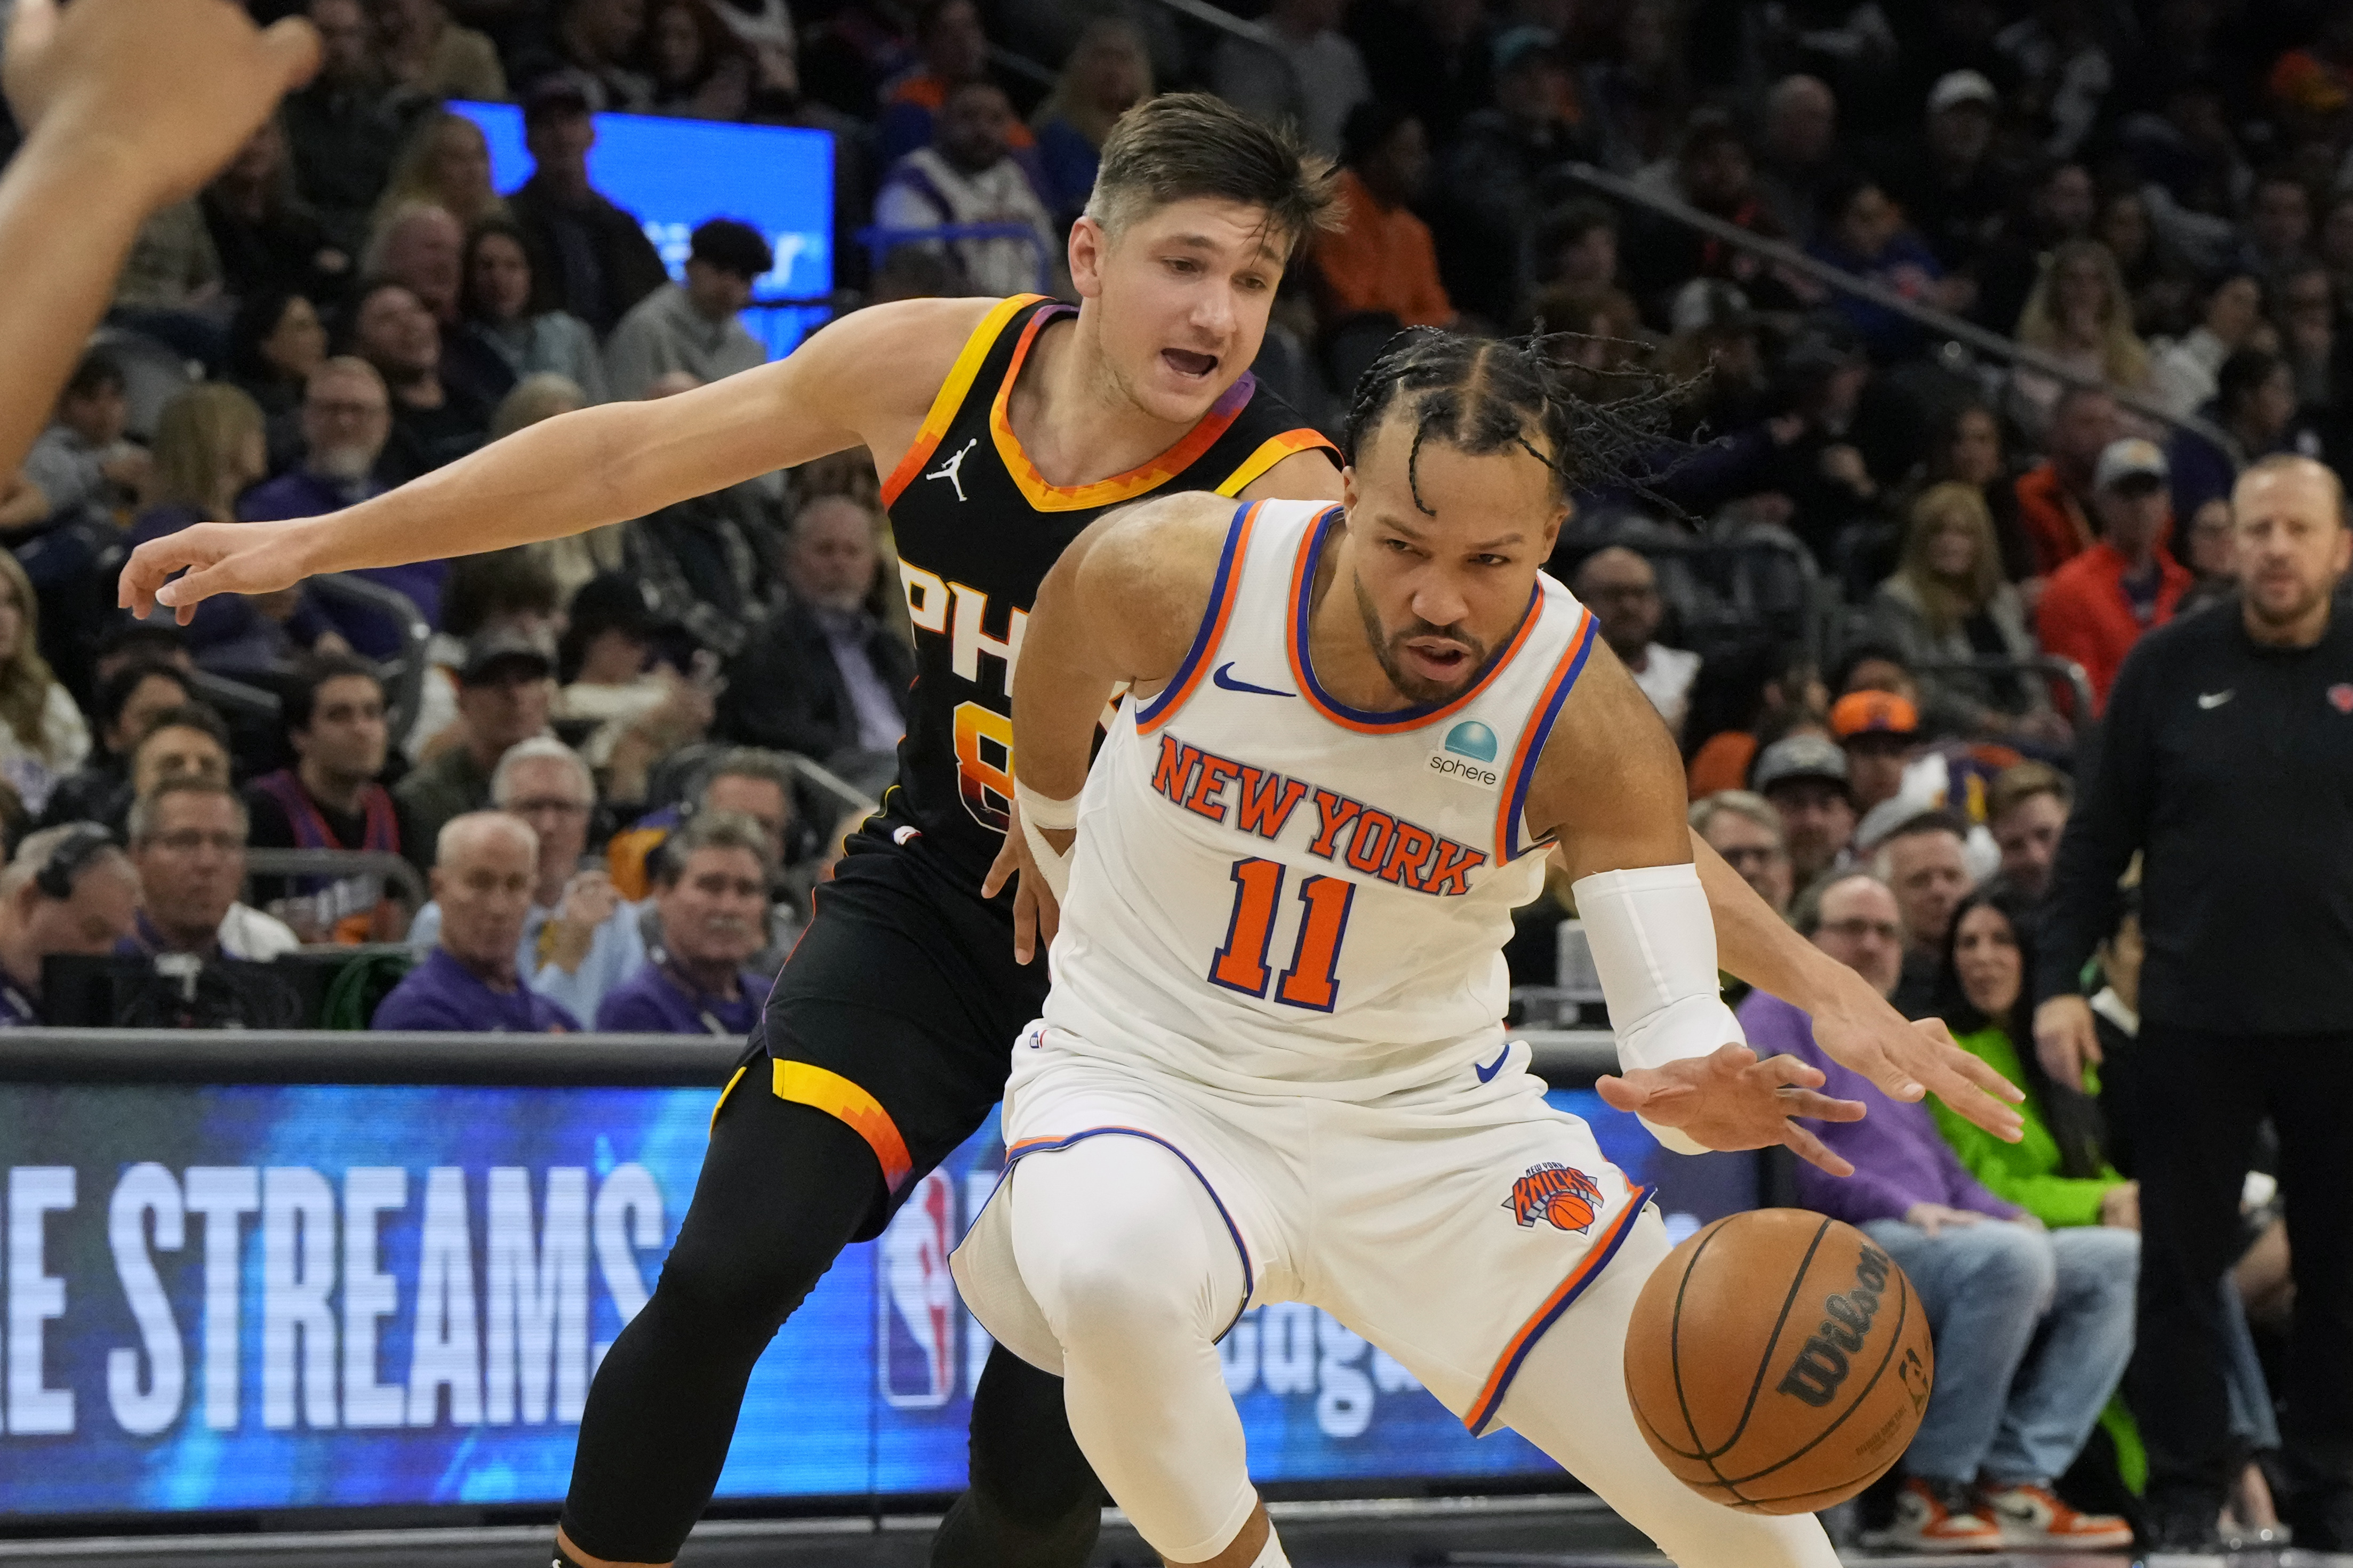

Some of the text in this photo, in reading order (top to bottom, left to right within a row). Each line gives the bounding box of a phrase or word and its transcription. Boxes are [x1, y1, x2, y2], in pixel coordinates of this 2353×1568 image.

[953, 701, 1013, 834] 8
[1150, 732, 1490, 897] NEW YORK
[1430, 757, 1496, 785] sphere
[1207, 856, 1356, 1013] 11
[1512, 1167, 1604, 1225] KNICKS
[1526, 1161, 1566, 1178] NEW YORK
[0, 1166, 76, 1434] E
[108, 1161, 663, 1435] STREAMS
[1777, 1240, 1889, 1407] Wilson
